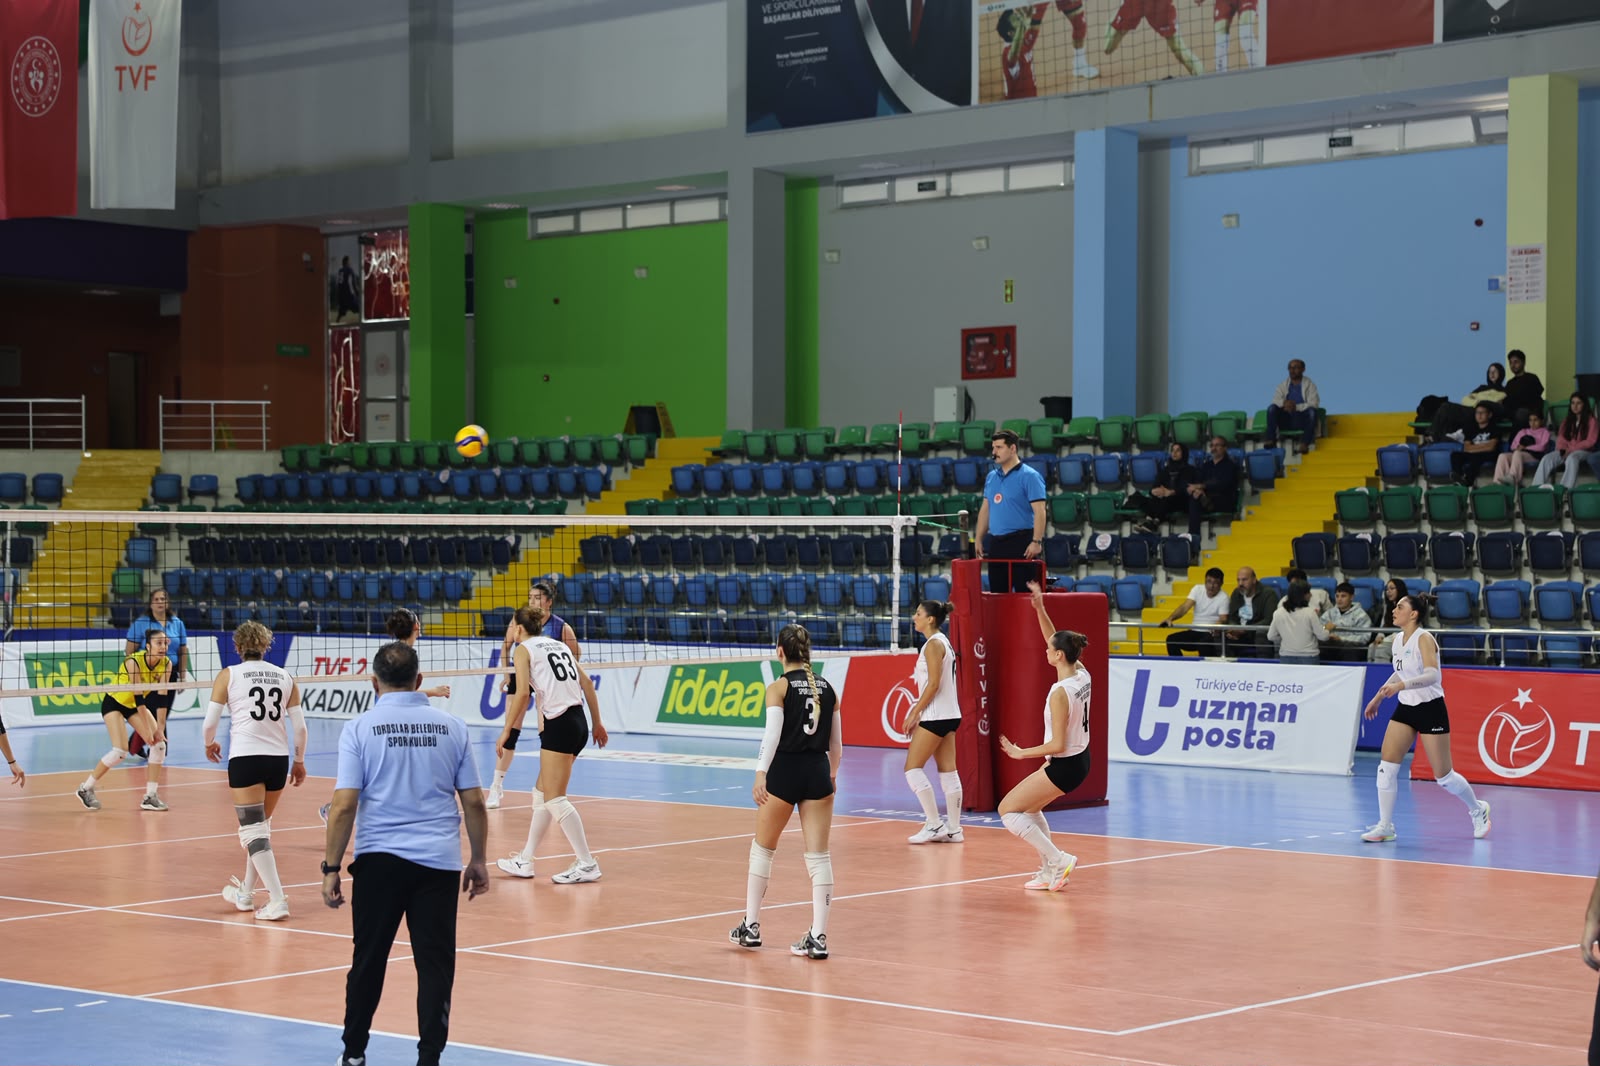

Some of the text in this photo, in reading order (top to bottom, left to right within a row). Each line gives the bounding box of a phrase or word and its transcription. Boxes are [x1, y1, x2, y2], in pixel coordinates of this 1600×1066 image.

[115, 65, 157, 92] TVF
[313, 656, 351, 675] TVF
[547, 652, 577, 682] 63
[32, 660, 119, 707] idda
[665, 667, 766, 718] iddaa
[1195, 678, 1304, 695] Türkiye'de E-posta
[248, 686, 283, 722] 33
[803, 697, 820, 736] 3
[1188, 699, 1298, 723] uzman
[372, 722, 449, 736] TOROSLAR BELEDİYESİ
[387, 734, 437, 748] SPOR KULÜBÜ
[1182, 722, 1276, 751] posta
